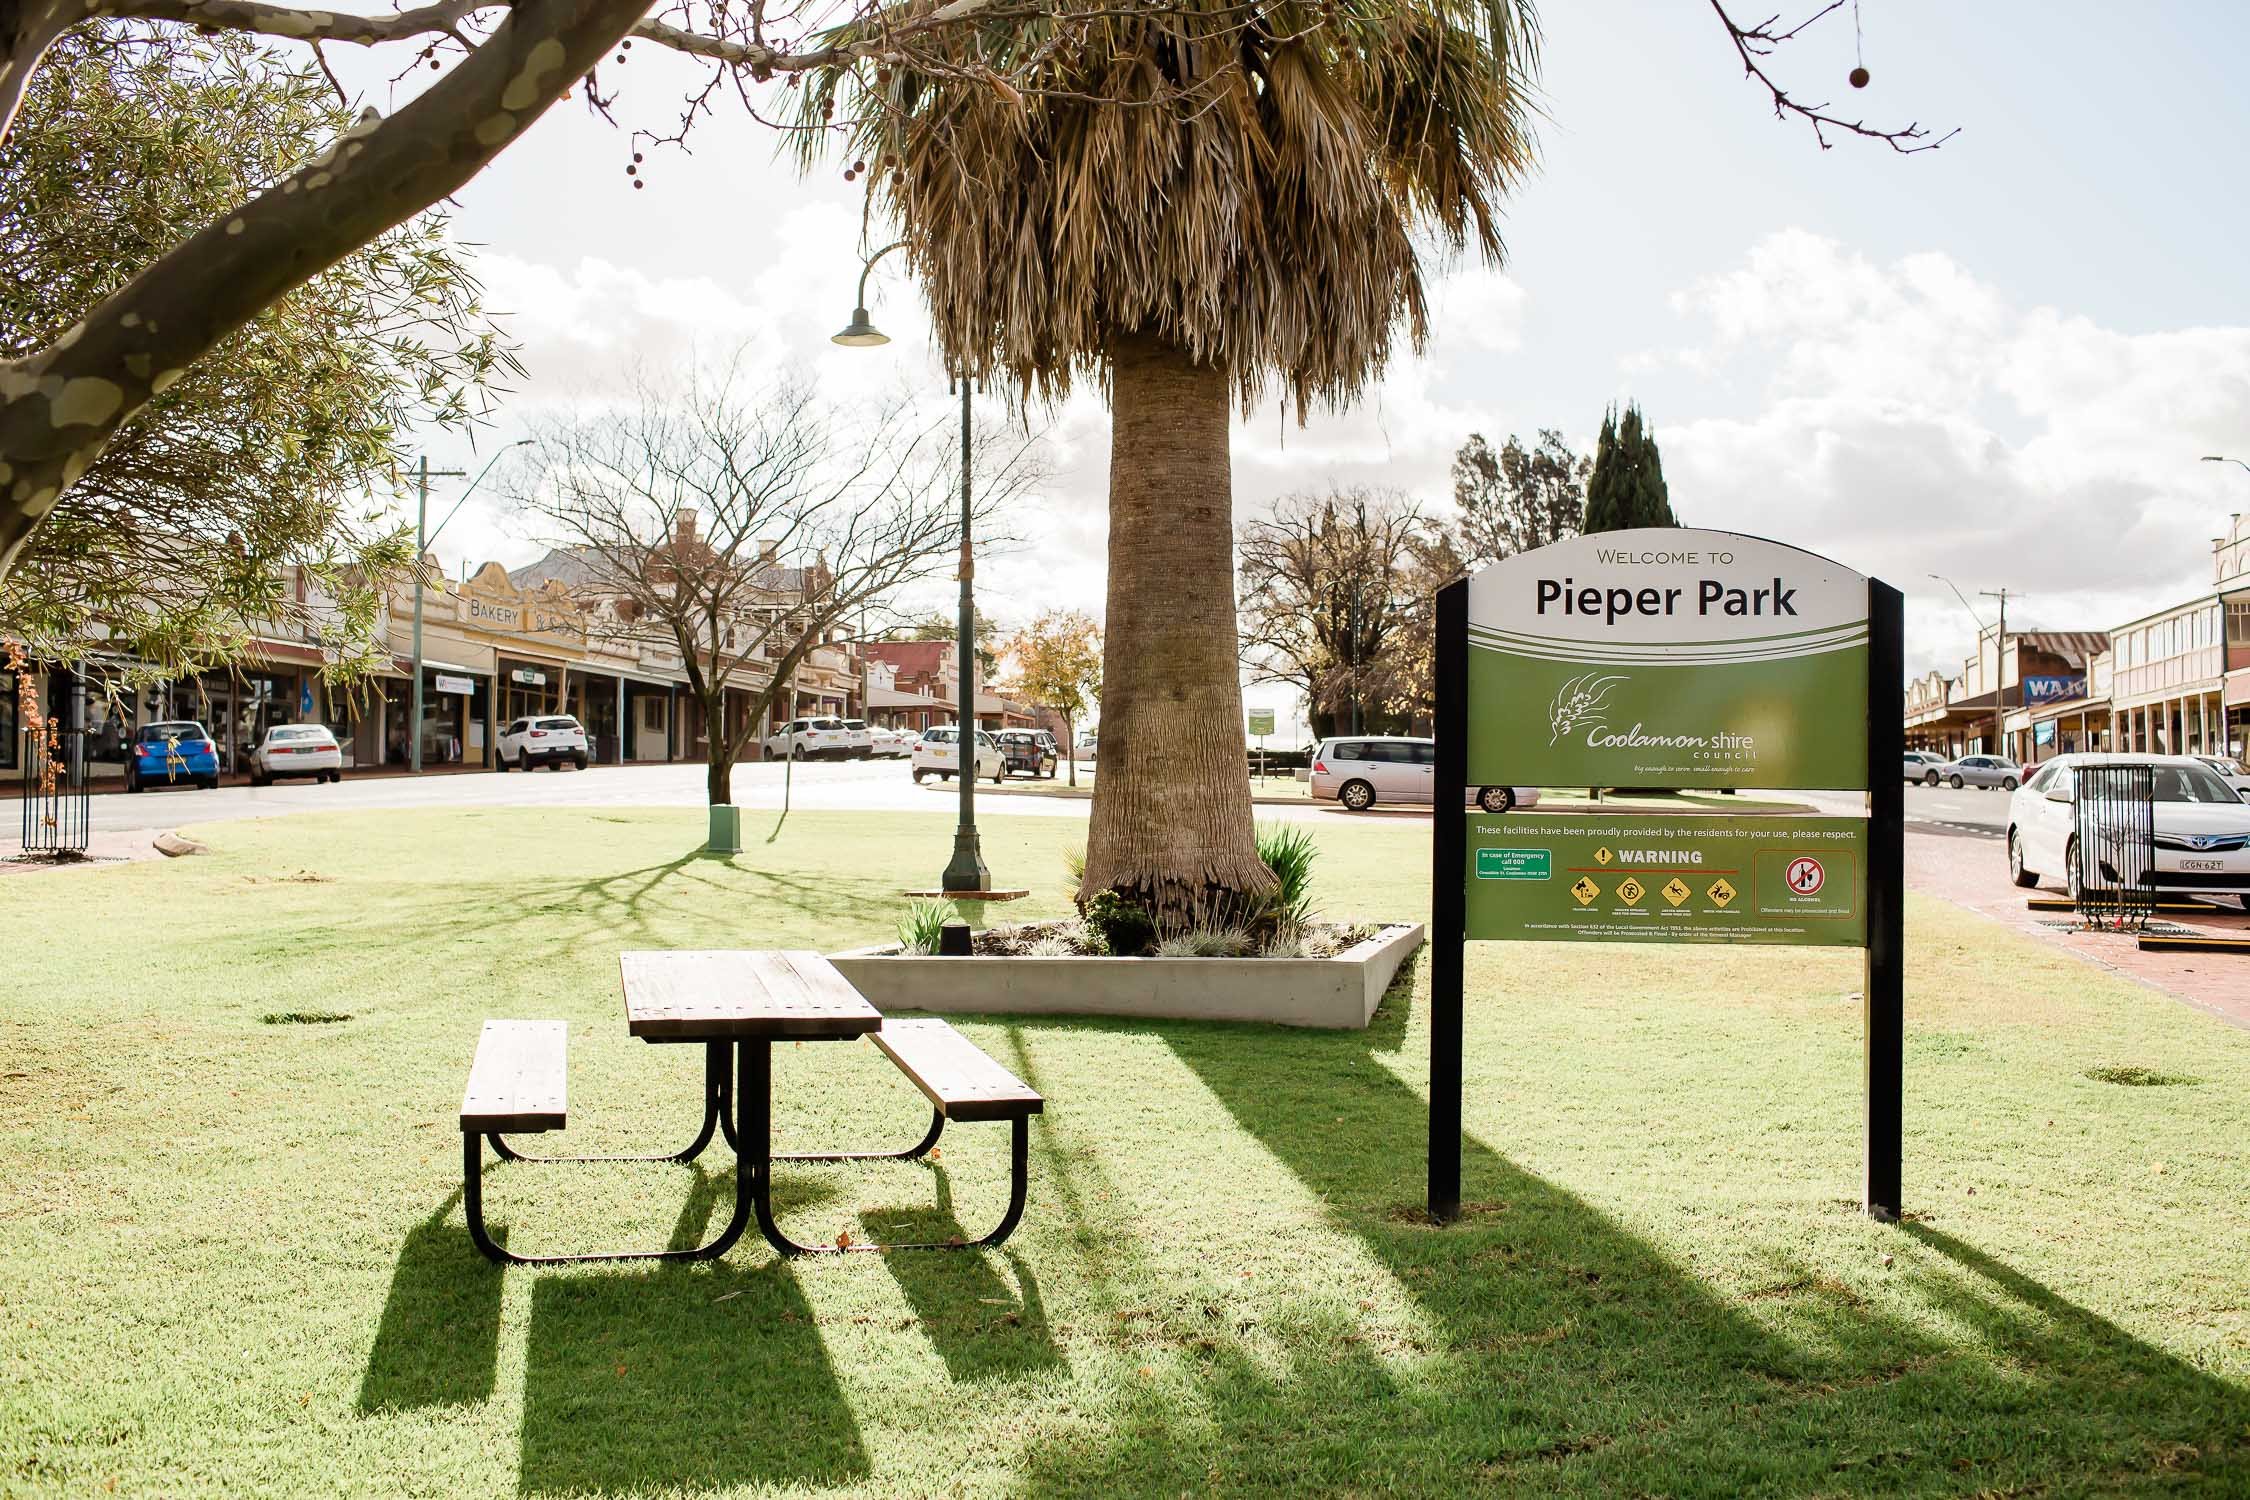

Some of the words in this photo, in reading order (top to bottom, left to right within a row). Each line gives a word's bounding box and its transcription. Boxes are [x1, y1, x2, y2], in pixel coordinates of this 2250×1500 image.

[1597, 549, 1699, 565] WELCOME
[1708, 552, 1733, 565] TO
[1537, 578, 1682, 626] Pieper
[1699, 578, 1798, 616] Park
[471, 600, 519, 625] BAKERY
[1587, 722, 1708, 748] Coolamon
[1711, 731, 1754, 749] shire
[1476, 826, 1501, 834] These
[1503, 826, 1539, 835] facilities
[1541, 827, 1561, 835] have
[1563, 827, 1585, 835] been
[1587, 828, 1620, 837] proudly
[1623, 828, 1662, 837] provided
[1664, 828, 1675, 838] by
[1677, 829, 1691, 837] the
[1693, 829, 1733, 837] residents
[1735, 829, 1748, 837] for
[1750, 831, 1770, 839] your
[1792, 829, 1820, 839] please
[1822, 831, 1856, 839] respect.
[1618, 850, 1703, 864] WARNING
